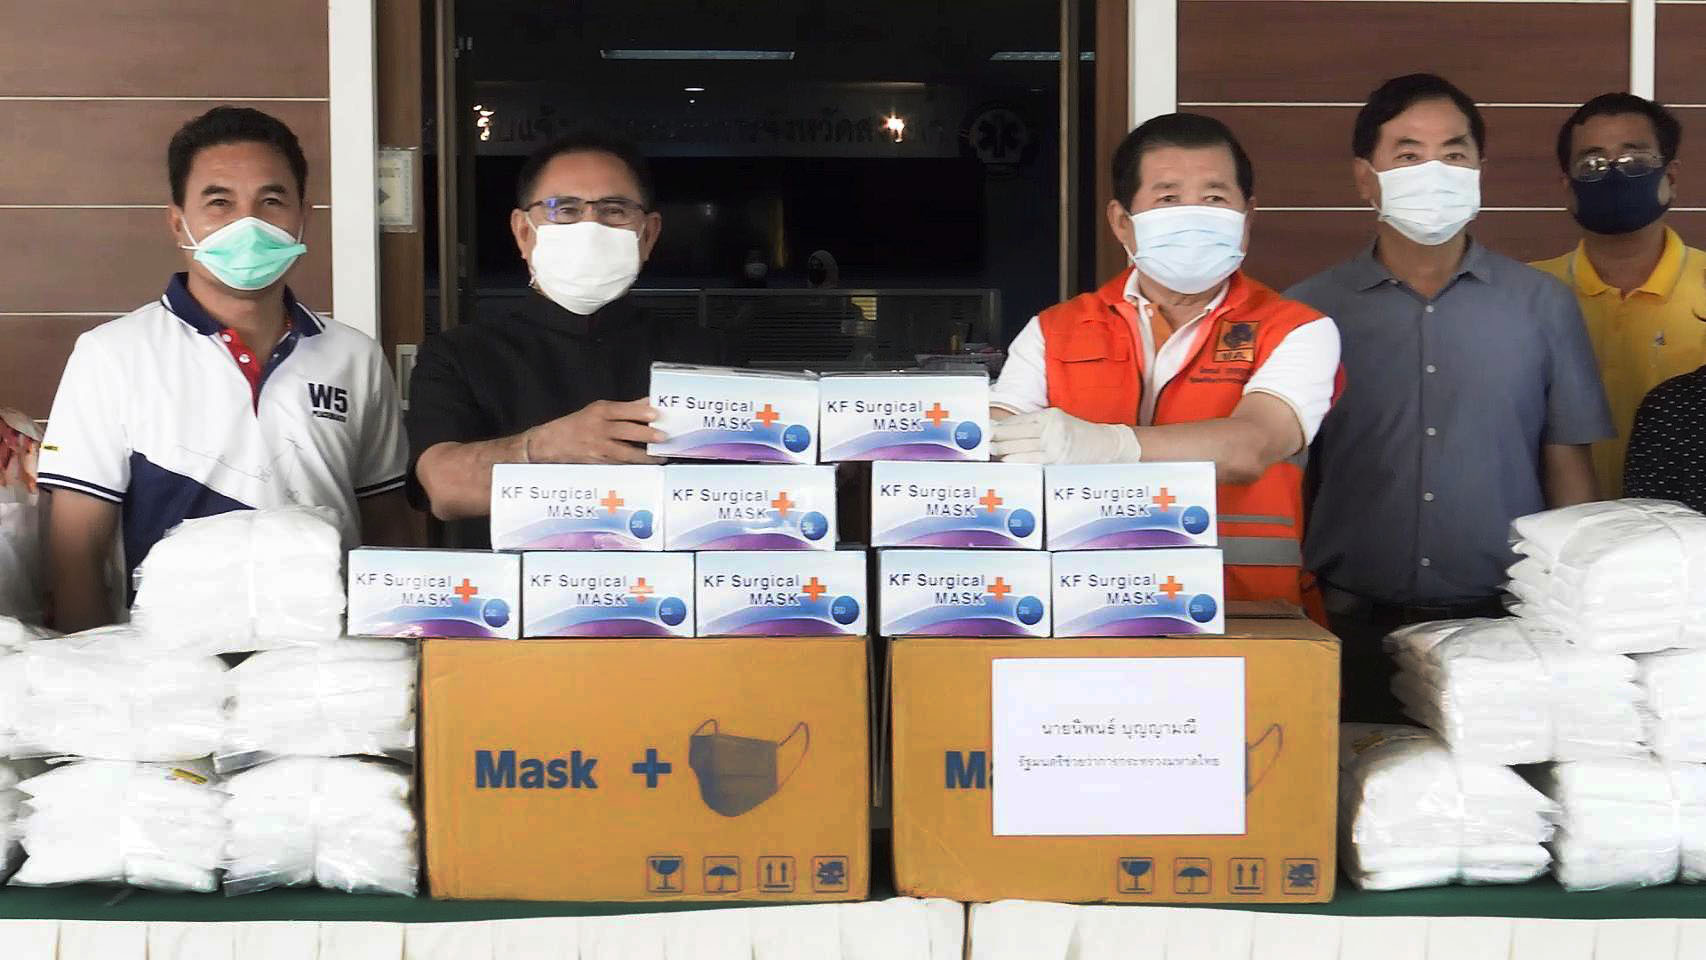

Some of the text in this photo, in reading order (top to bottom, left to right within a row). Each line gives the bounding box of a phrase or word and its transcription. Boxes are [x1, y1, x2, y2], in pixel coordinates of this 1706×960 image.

[308, 383, 348, 413] W5
[658, 396, 754, 414] KF Surgical
[827, 401, 922, 414] KF Surgical
[704, 416, 753, 431] MASK
[873, 418, 922, 431] MASK
[501, 487, 598, 501] KF Surgical
[673, 489, 769, 503] KF Surgical
[880, 485, 977, 499] KF Surgical
[1054, 486, 1149, 500] KF Surgical
[547, 505, 598, 518] MASK
[718, 507, 767, 520] MASK
[926, 504, 976, 517] MASK
[1101, 504, 1149, 517] MASK
[355, 573, 452, 589] KF Surgical
[530, 574, 628, 589] KF Surgical
[704, 573, 800, 589] KF Surgical
[889, 574, 985, 589] KF Surgical
[1060, 574, 1156, 588] KF Surgical
[401, 593, 451, 606] MASK
[577, 593, 628, 606] MASK
[750, 593, 800, 606] MASK
[935, 592, 985, 605] MASK
[1107, 592, 1156, 605] MASK
[475, 750, 598, 789] Mask
[945, 751, 992, 790] M
